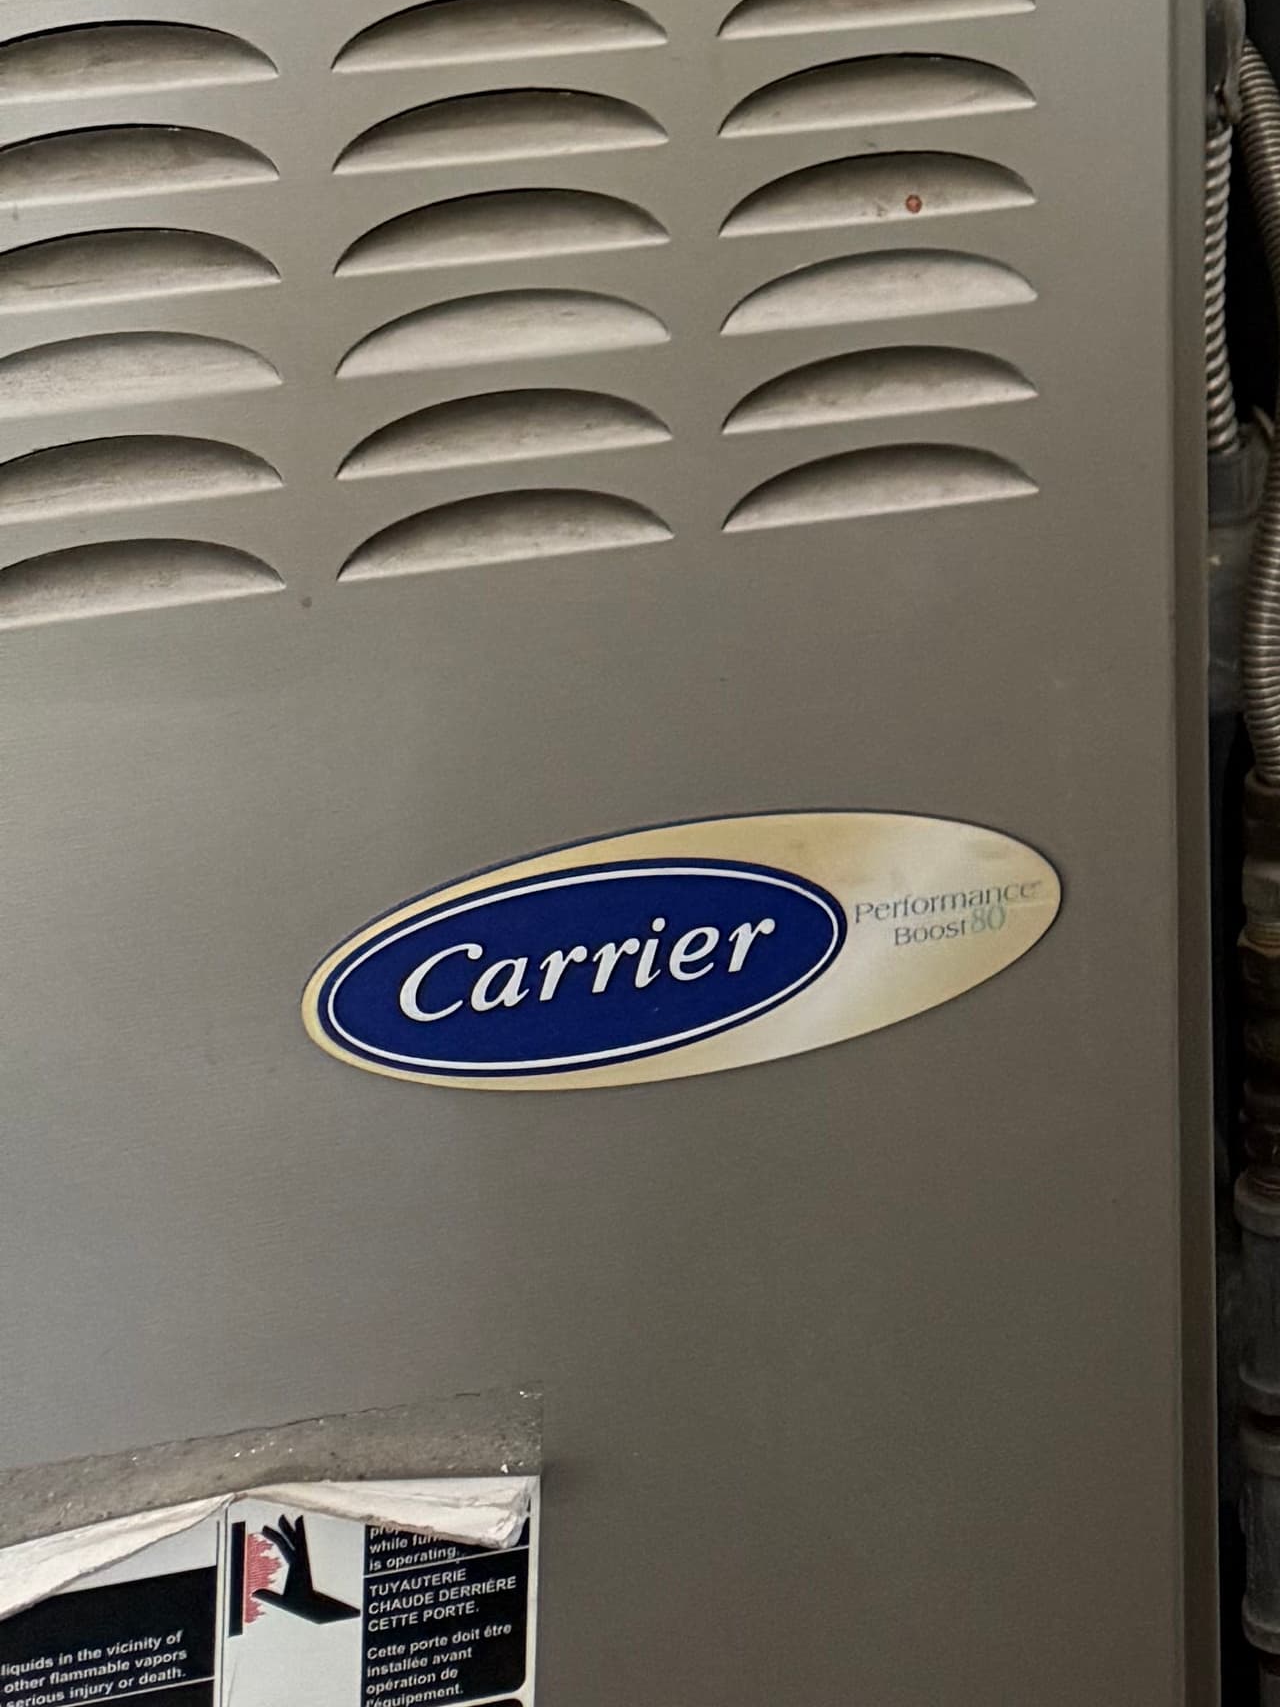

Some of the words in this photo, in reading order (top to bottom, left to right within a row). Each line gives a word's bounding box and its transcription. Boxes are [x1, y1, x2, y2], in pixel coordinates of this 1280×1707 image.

[398, 916, 776, 1024] Carrier
[369, 1539, 408, 1554] while
[369, 1560, 382, 1571] is
[369, 1569, 467, 1597] TUYAUTERIE
[367, 1612, 418, 1632] CETTE
[423, 1600, 480, 1622] PORTE.
[368, 1592, 434, 1615] CHAUDE
[1, 1656, 54, 1677] liquids
[58, 1652, 73, 1666] in
[77, 1648, 102, 1662] the
[106, 1637, 162, 1657] vicinity
[166, 1629, 184, 1645] of
[367, 1644, 406, 1660] Cette
[409, 1636, 448, 1654] porte
[452, 1627, 480, 1643] doit
[4, 1675, 46, 1694] other
[49, 1659, 130, 1686] flammable
[134, 1649, 187, 1669] vapors
[367, 1656, 428, 1678] installée
[432, 1647, 473, 1664] avant
[69, 1681, 114, 1699] injury
[118, 1678, 134, 1688] or
[138, 1666, 187, 1685] death.
[365, 1672, 436, 1696] opération
[440, 1668, 459, 1680] de
